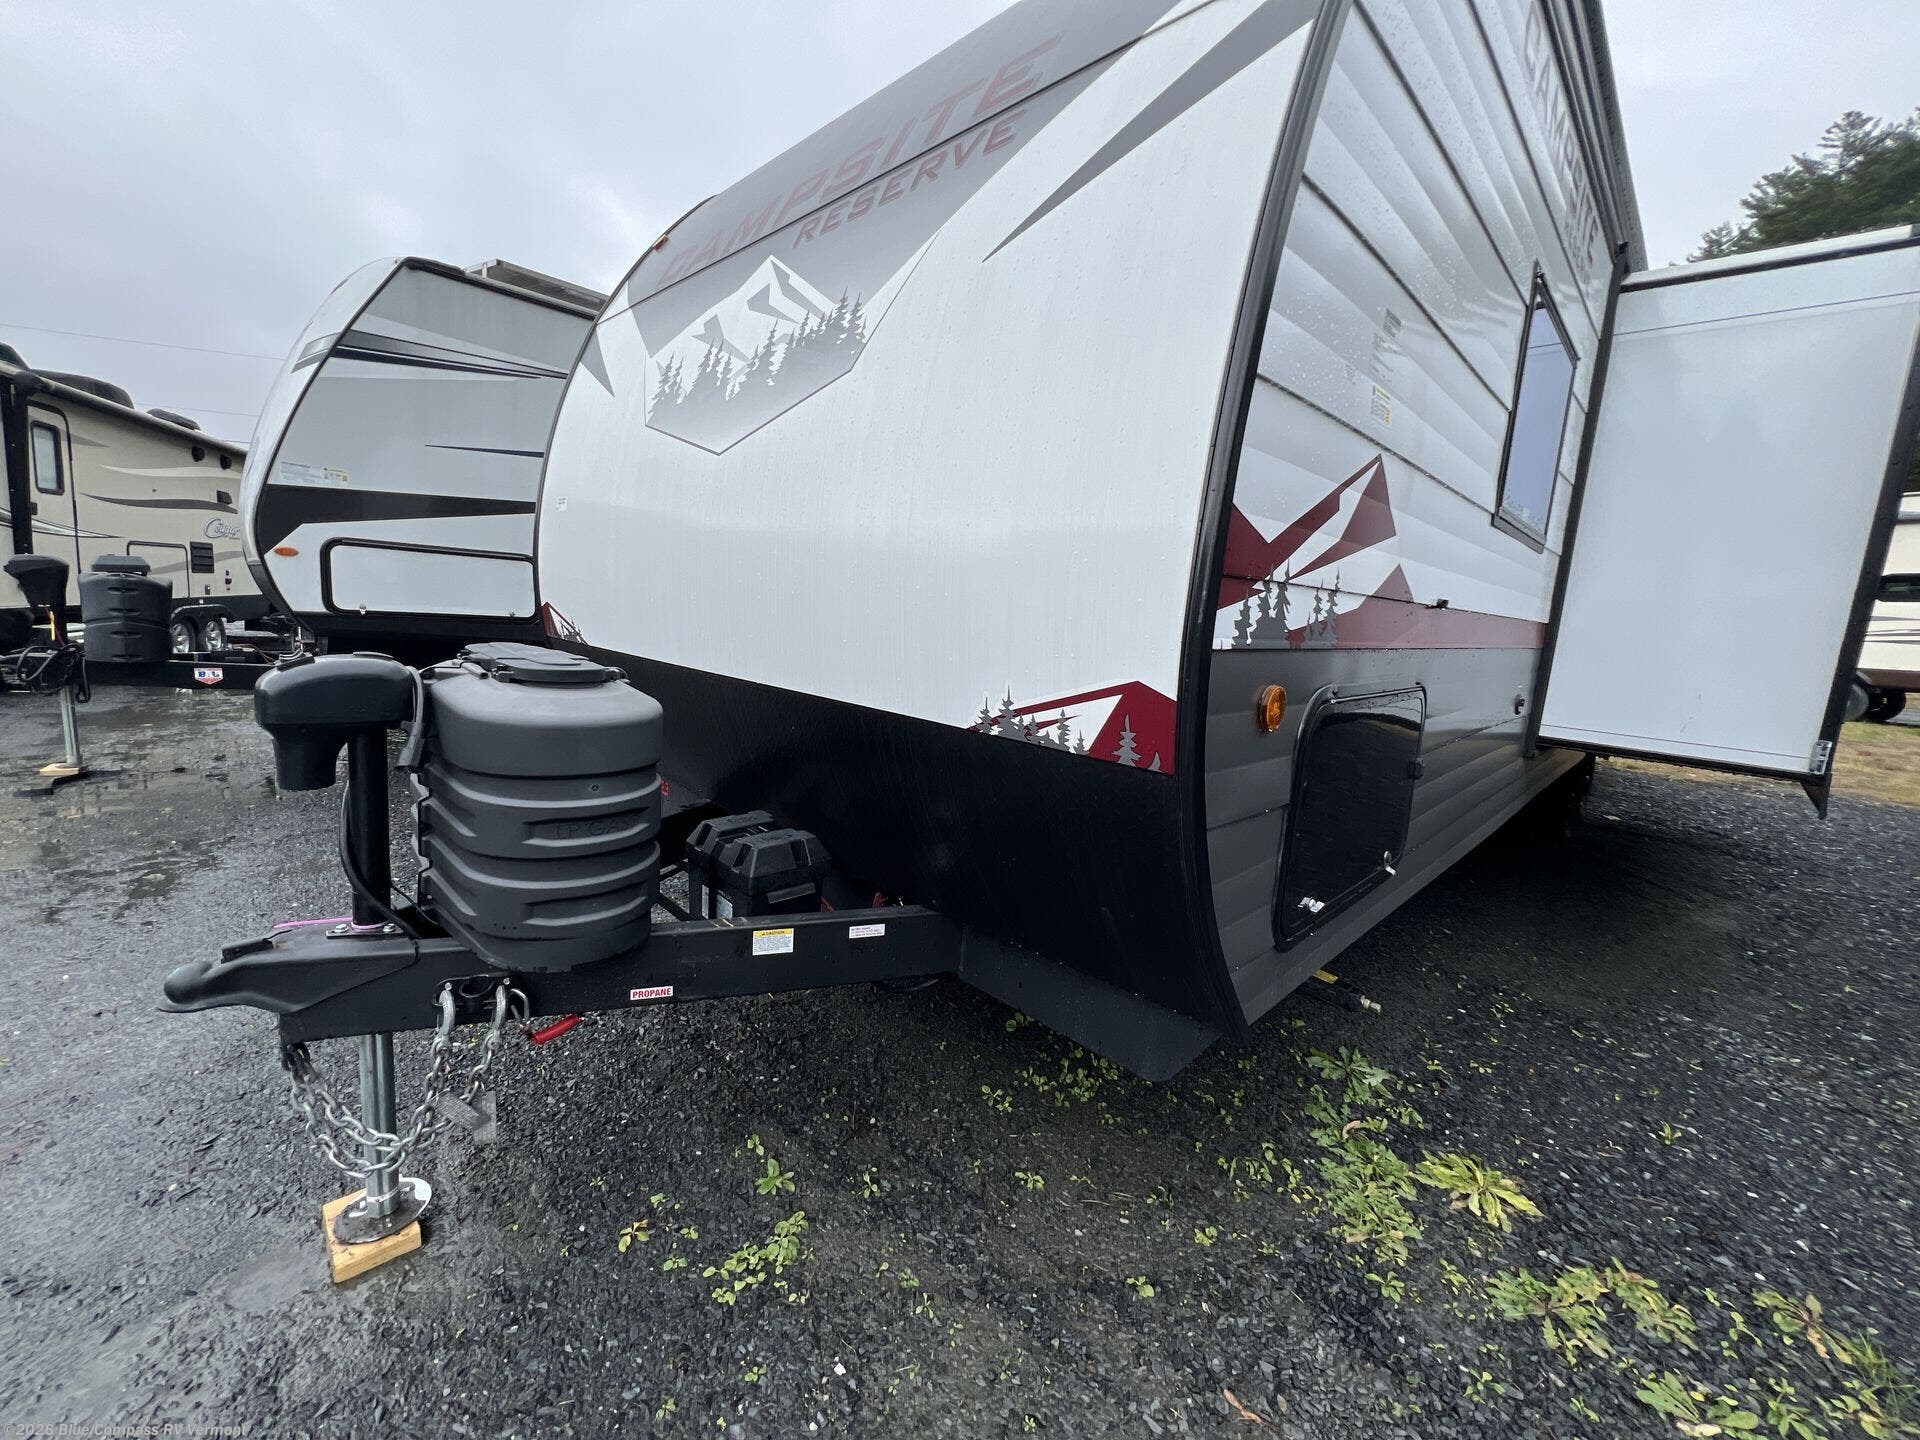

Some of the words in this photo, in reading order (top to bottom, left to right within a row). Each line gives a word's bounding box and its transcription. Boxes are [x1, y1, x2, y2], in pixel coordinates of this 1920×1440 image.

[657, 31, 1065, 288] CAMPSITE
[793, 109, 1028, 249] RESERVE
[1524, 0, 1598, 267] CAMPSITE
[632, 988, 672, 998] PROPANE
